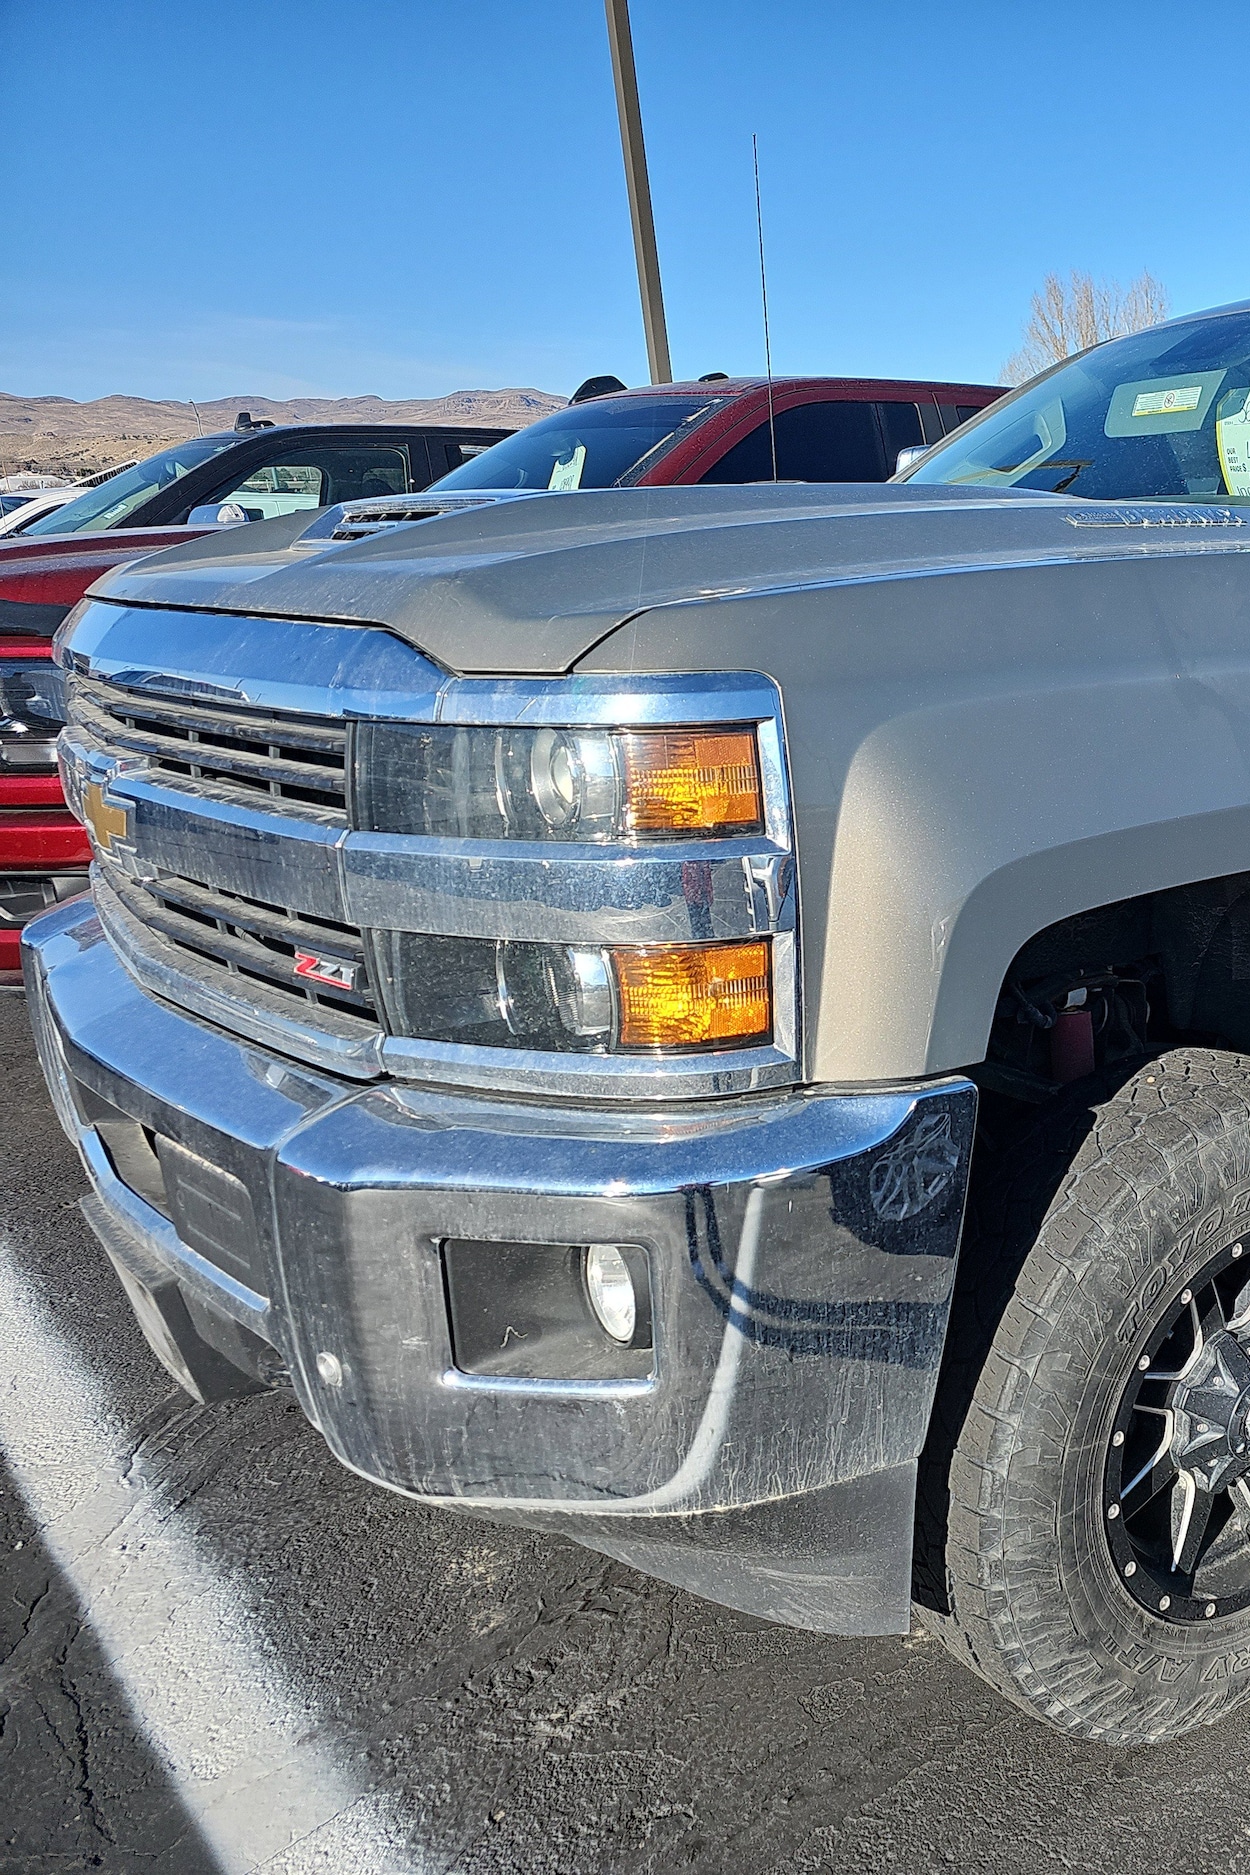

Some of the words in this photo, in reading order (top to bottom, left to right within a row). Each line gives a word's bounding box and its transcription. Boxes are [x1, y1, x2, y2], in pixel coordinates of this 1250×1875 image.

[1226, 447, 1236, 455] OUR
[1229, 464, 1242, 472] PRICE
[293, 952, 353, 991] Z71
[1115, 1206, 1225, 1345] TOYO
[1114, 1643, 1195, 1684] A/T
